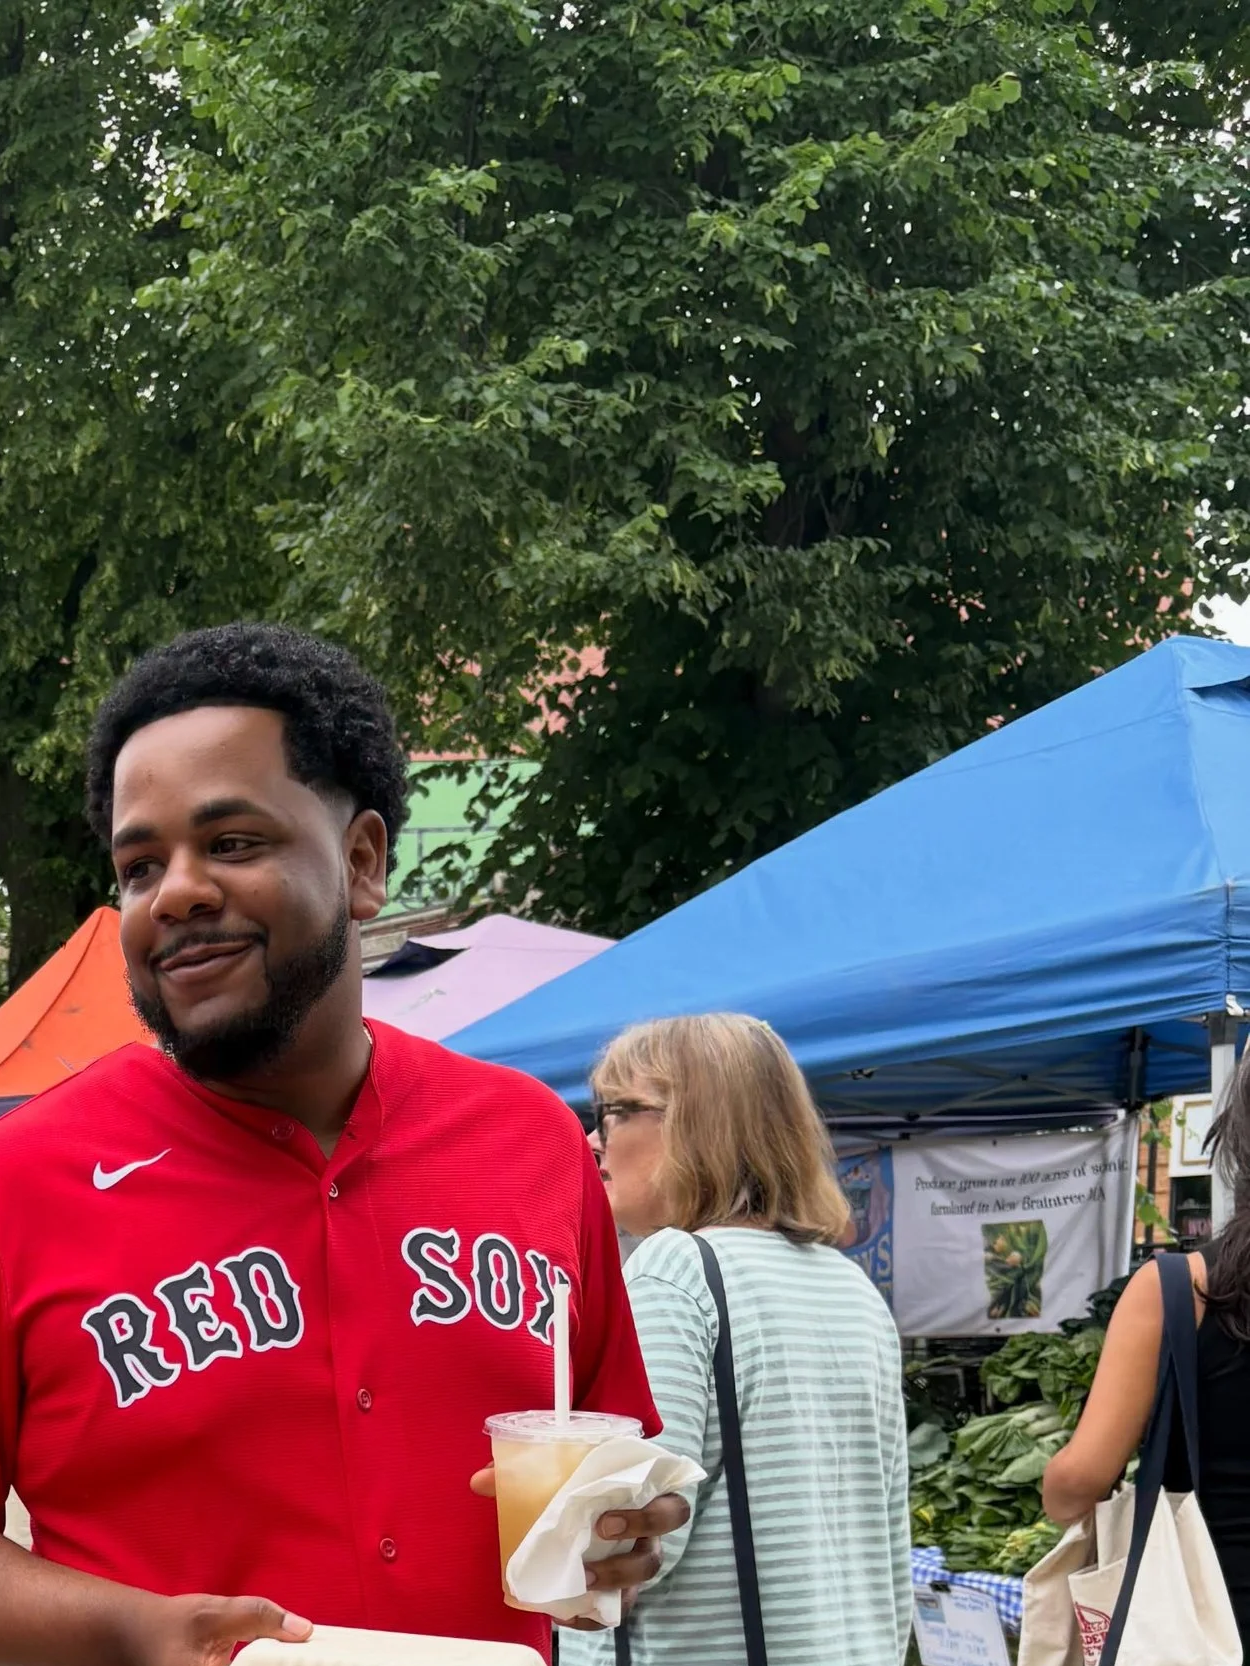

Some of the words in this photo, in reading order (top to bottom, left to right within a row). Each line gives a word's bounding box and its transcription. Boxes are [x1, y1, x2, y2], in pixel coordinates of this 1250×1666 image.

[914, 1175, 957, 1192] Produce
[958, 1176, 998, 1194] grown
[1000, 1176, 1016, 1189] on
[1018, 1171, 1041, 1185] 100
[1040, 1169, 1070, 1183] acres
[1072, 1161, 1088, 1178] of
[930, 1200, 976, 1217] farmland
[977, 1201, 990, 1215] in
[992, 1198, 1018, 1214] New
[1085, 1185, 1107, 1202] MA
[81, 1246, 304, 1408] RED
